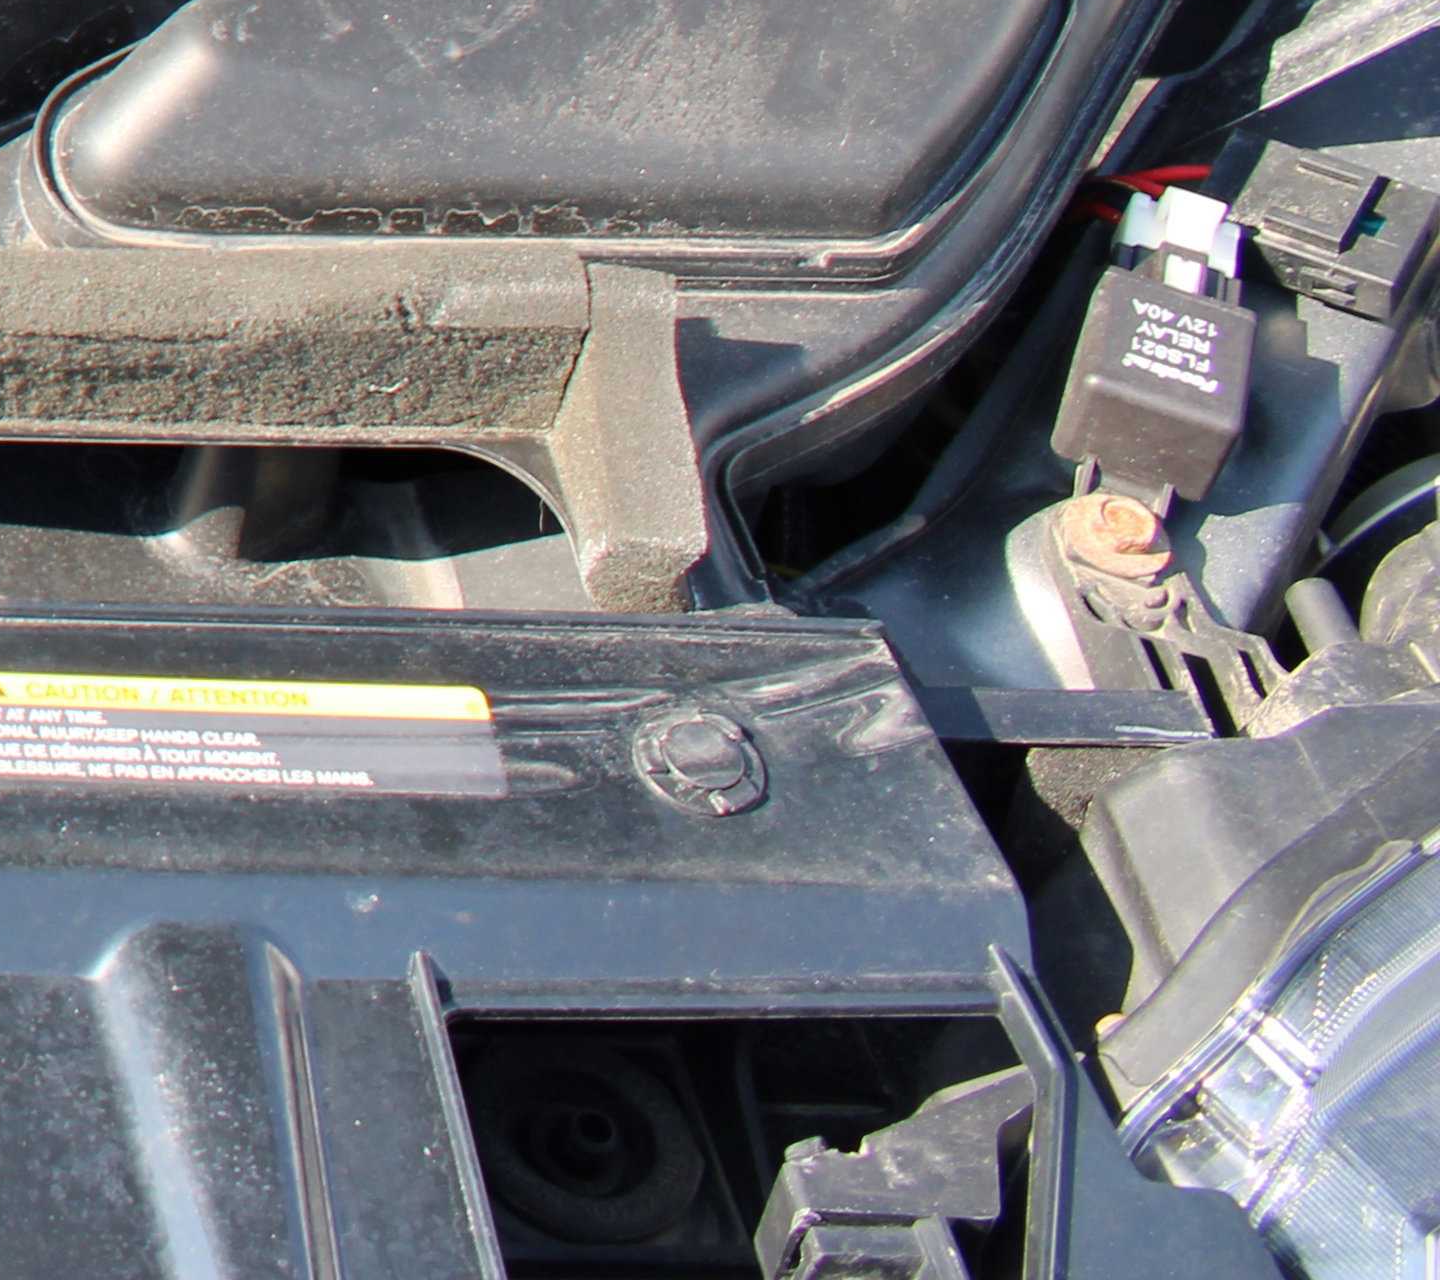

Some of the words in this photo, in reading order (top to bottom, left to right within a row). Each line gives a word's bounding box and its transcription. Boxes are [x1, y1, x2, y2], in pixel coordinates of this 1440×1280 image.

[1131, 298, 1176, 322] 40A
[1135, 321, 1212, 354] RELAY
[1176, 317, 1218, 338] 12V
[25, 680, 139, 702] CAUTION
[170, 687, 310, 708] ATTENTION
[6, 708, 26, 722] AT
[29, 708, 62, 723] ANY
[64, 710, 108, 725] TIME.
[141, 729, 200, 746] HANDS
[202, 730, 262, 747] CLEAR.
[23, 743, 48, 759] DE
[51, 741, 141, 761] DÉMARRER
[160, 748, 202, 764] TOUT
[204, 750, 281, 767] MOMENT.
[88, 762, 112, 778] NE
[114, 763, 148, 780] PAS
[152, 765, 175, 780] EN
[177, 766, 281, 784] APPROCHER
[282, 769, 314, 784] LES
[316, 770, 376, 786] MAINS.
